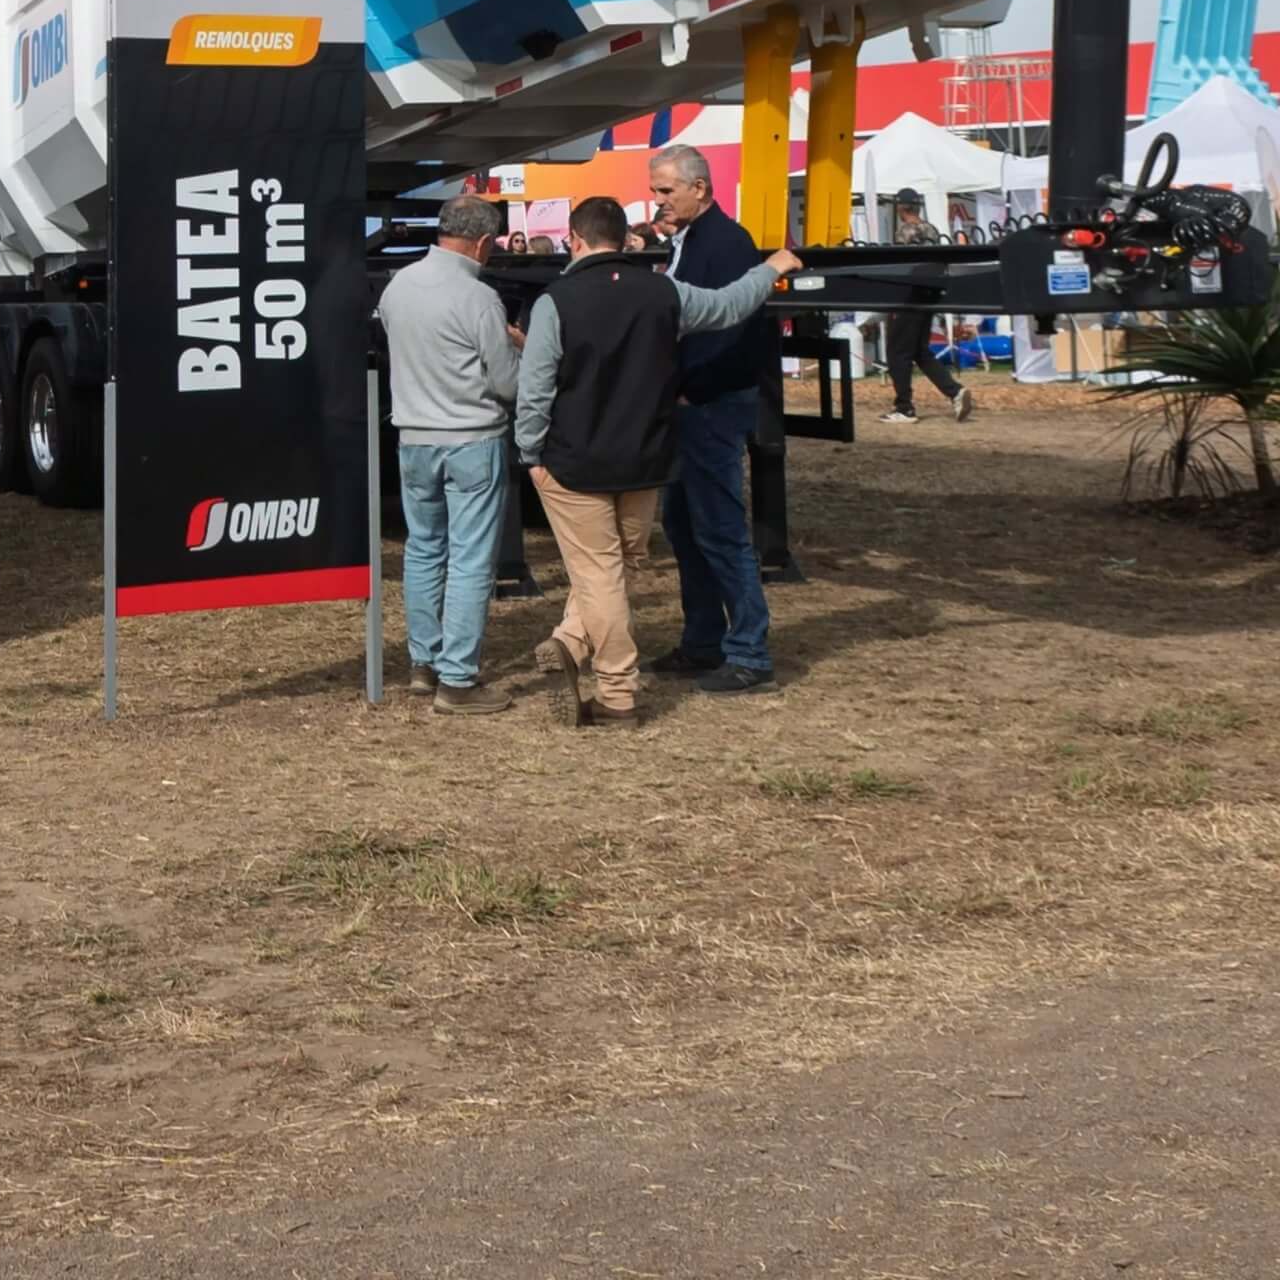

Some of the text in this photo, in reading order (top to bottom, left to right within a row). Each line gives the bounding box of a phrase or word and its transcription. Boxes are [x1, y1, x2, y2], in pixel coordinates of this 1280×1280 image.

[195, 30, 295, 53] REMOLQUES
[176, 169, 242, 392] BATEA
[254, 278, 308, 361] 50
[229, 497, 320, 543] OMBU
